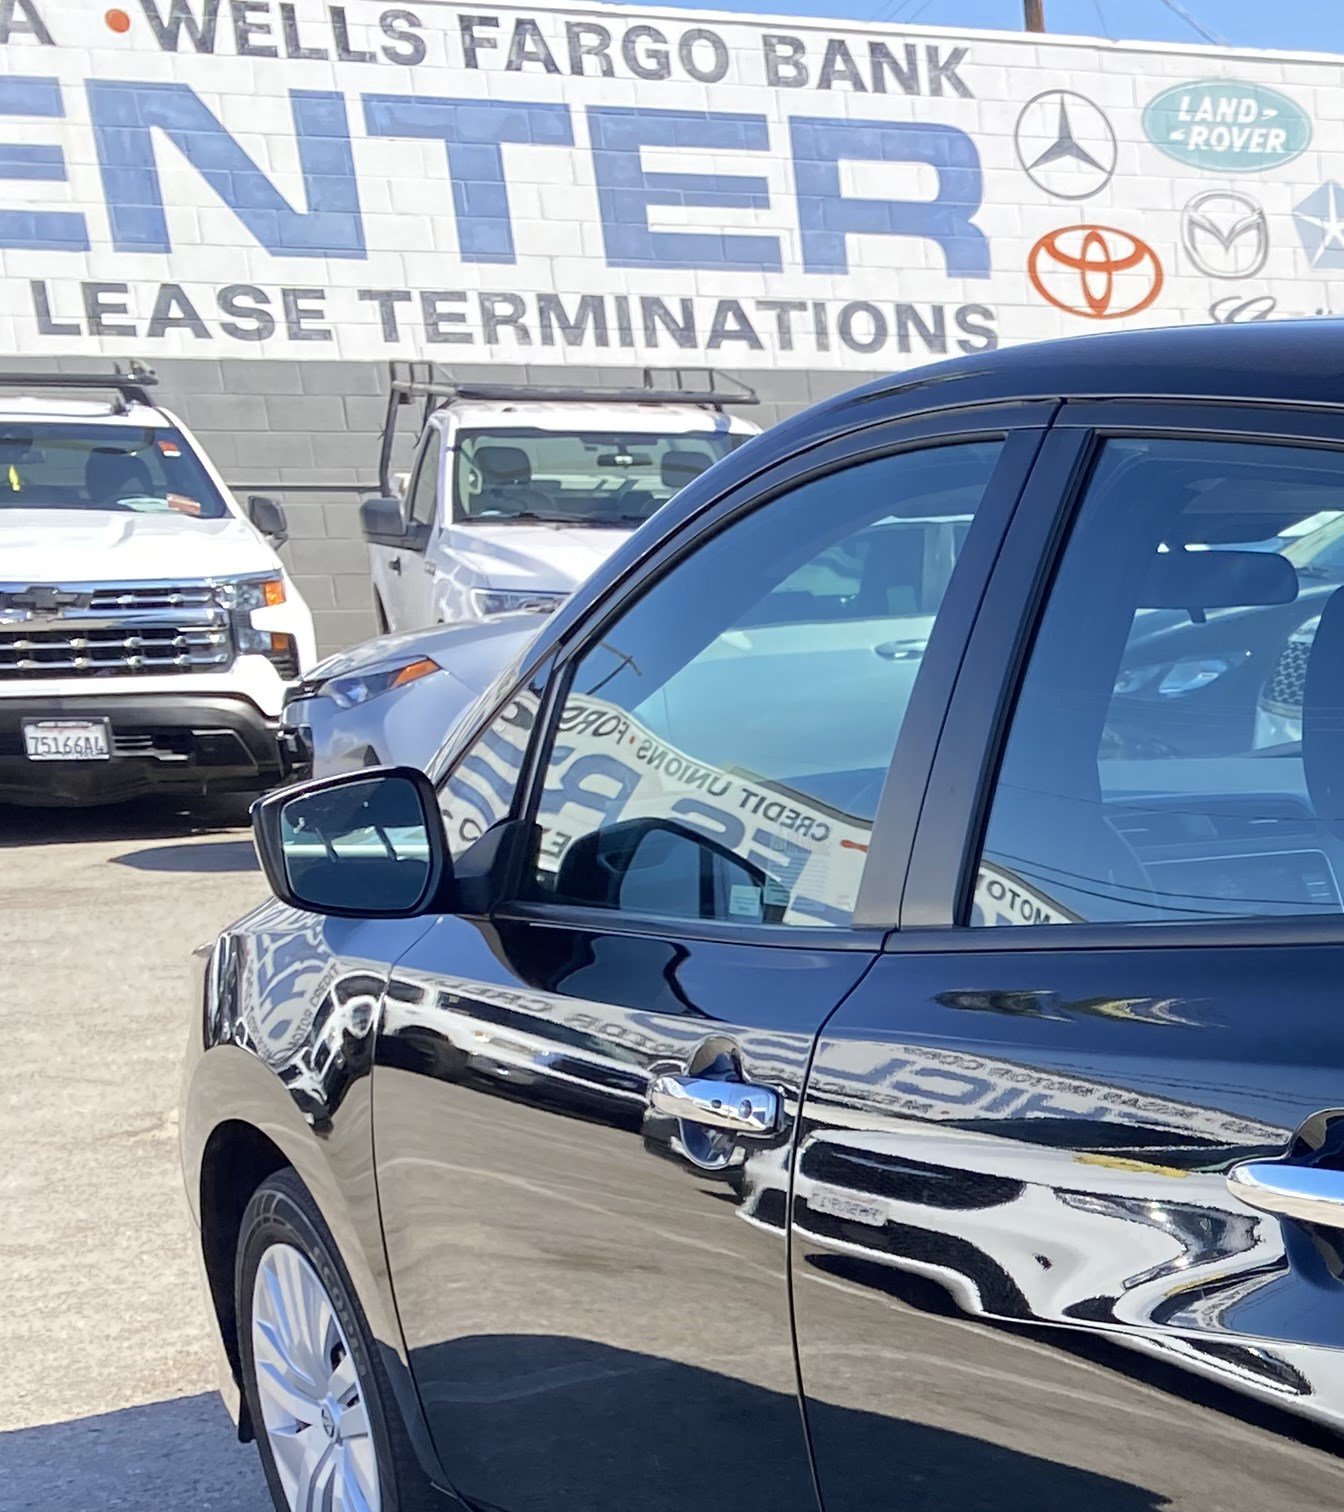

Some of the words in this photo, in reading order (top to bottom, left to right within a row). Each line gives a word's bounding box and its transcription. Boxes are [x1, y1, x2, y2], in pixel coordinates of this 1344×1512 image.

[136, 0, 427, 66] WELLS
[459, 13, 731, 84] FARGO
[760, 34, 974, 99] BANK
[1178, 95, 1258, 124] LAND
[1188, 126, 1287, 154] ROVER
[30, 280, 332, 342] LEASE
[358, 289, 999, 355] TERMINATIONS
